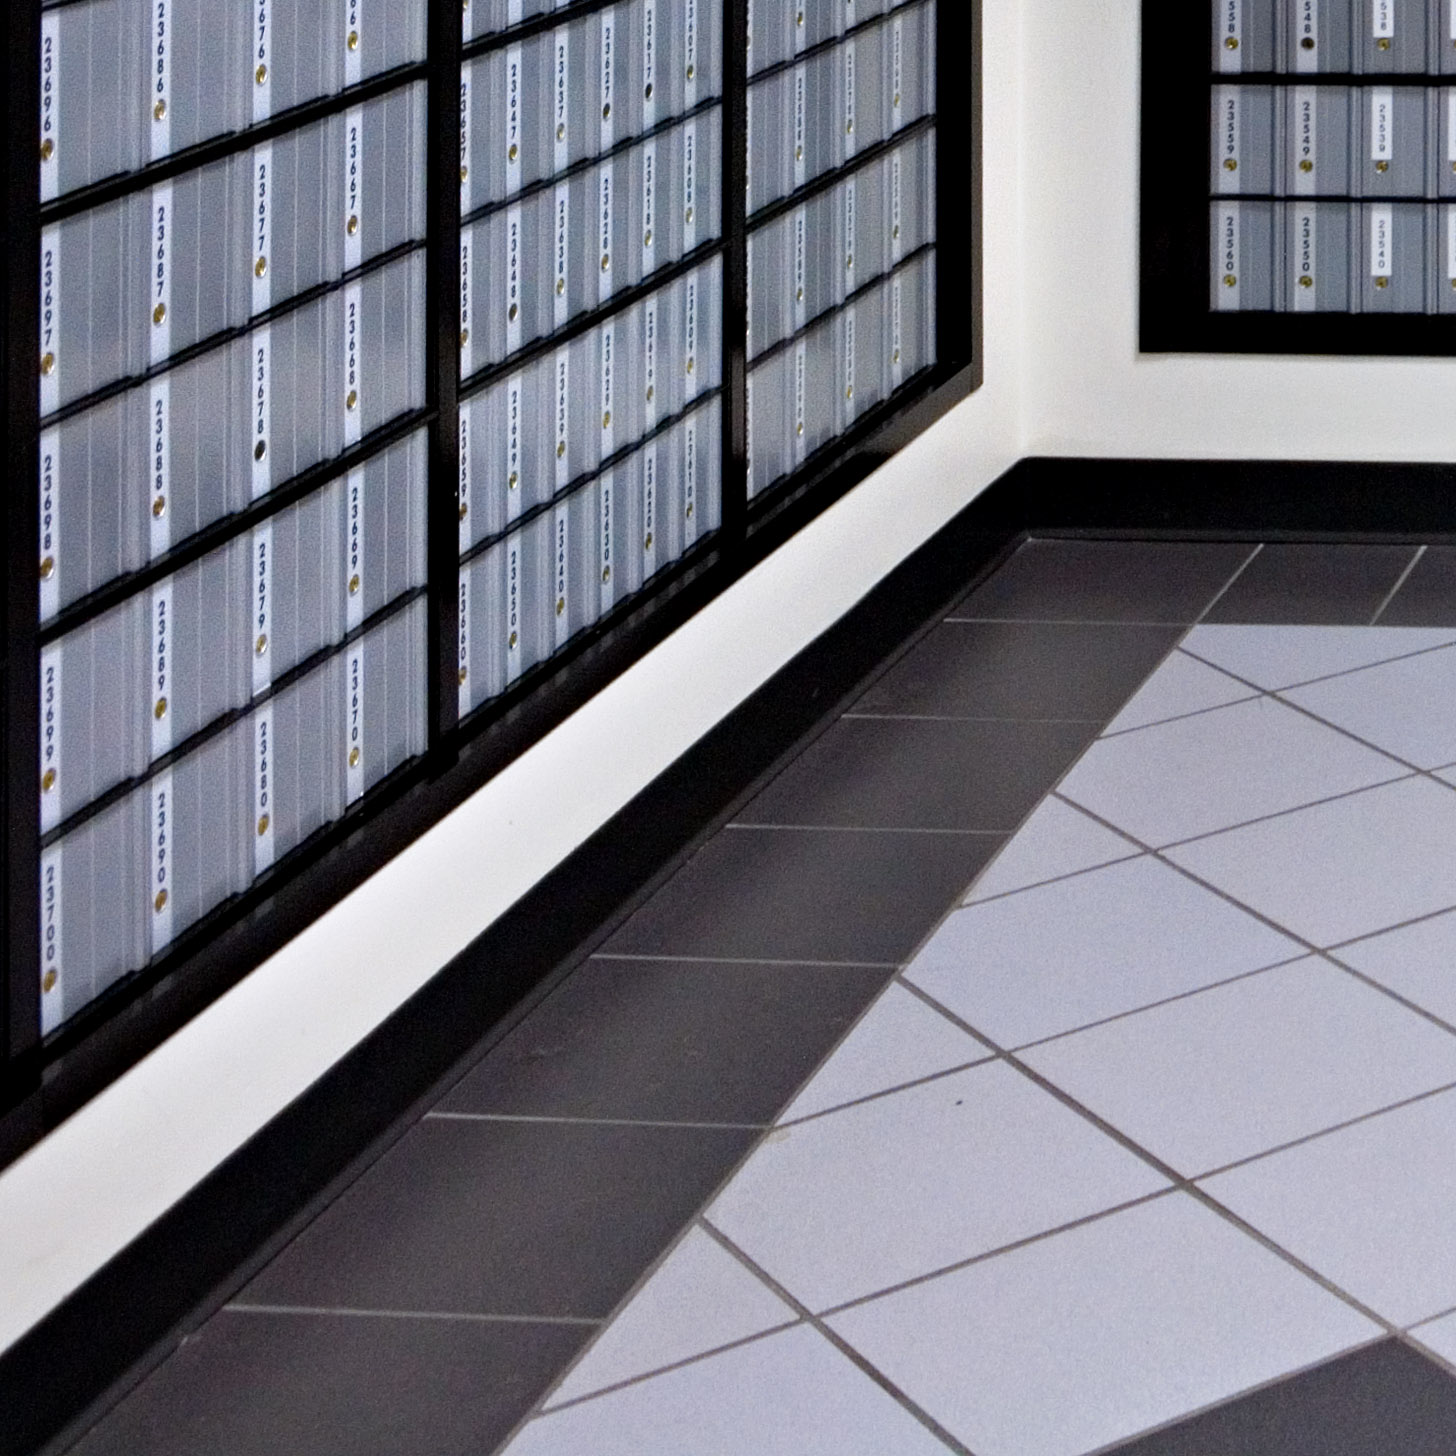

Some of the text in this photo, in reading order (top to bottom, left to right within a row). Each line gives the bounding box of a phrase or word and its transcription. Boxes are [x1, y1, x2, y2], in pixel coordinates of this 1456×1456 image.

[43, 38, 53, 132] 23696
[156, 2, 166, 94] 23686
[348, 128, 358, 210] 23667
[1226, 100, 1237, 154] 23559
[257, 165, 267, 251] 23677
[1301, 217, 1312, 272] 23550
[156, 208, 166, 298] 23687
[43, 252, 53, 346] 23697
[348, 304, 357, 386] 23668
[256, 348, 266, 435] 23678
[154, 399, 164, 490] 23688
[42, 456, 53, 551] 23698
[350, 487, 359, 570] 23669
[257, 543, 267, 629] 23679
[156, 600, 166, 692] 23689
[44, 668, 55, 761] 23699
[350, 658, 359, 742] 23670
[259, 721, 268, 807] 23680
[157, 792, 166, 884] 23690
[45, 867, 56, 960] 23700
